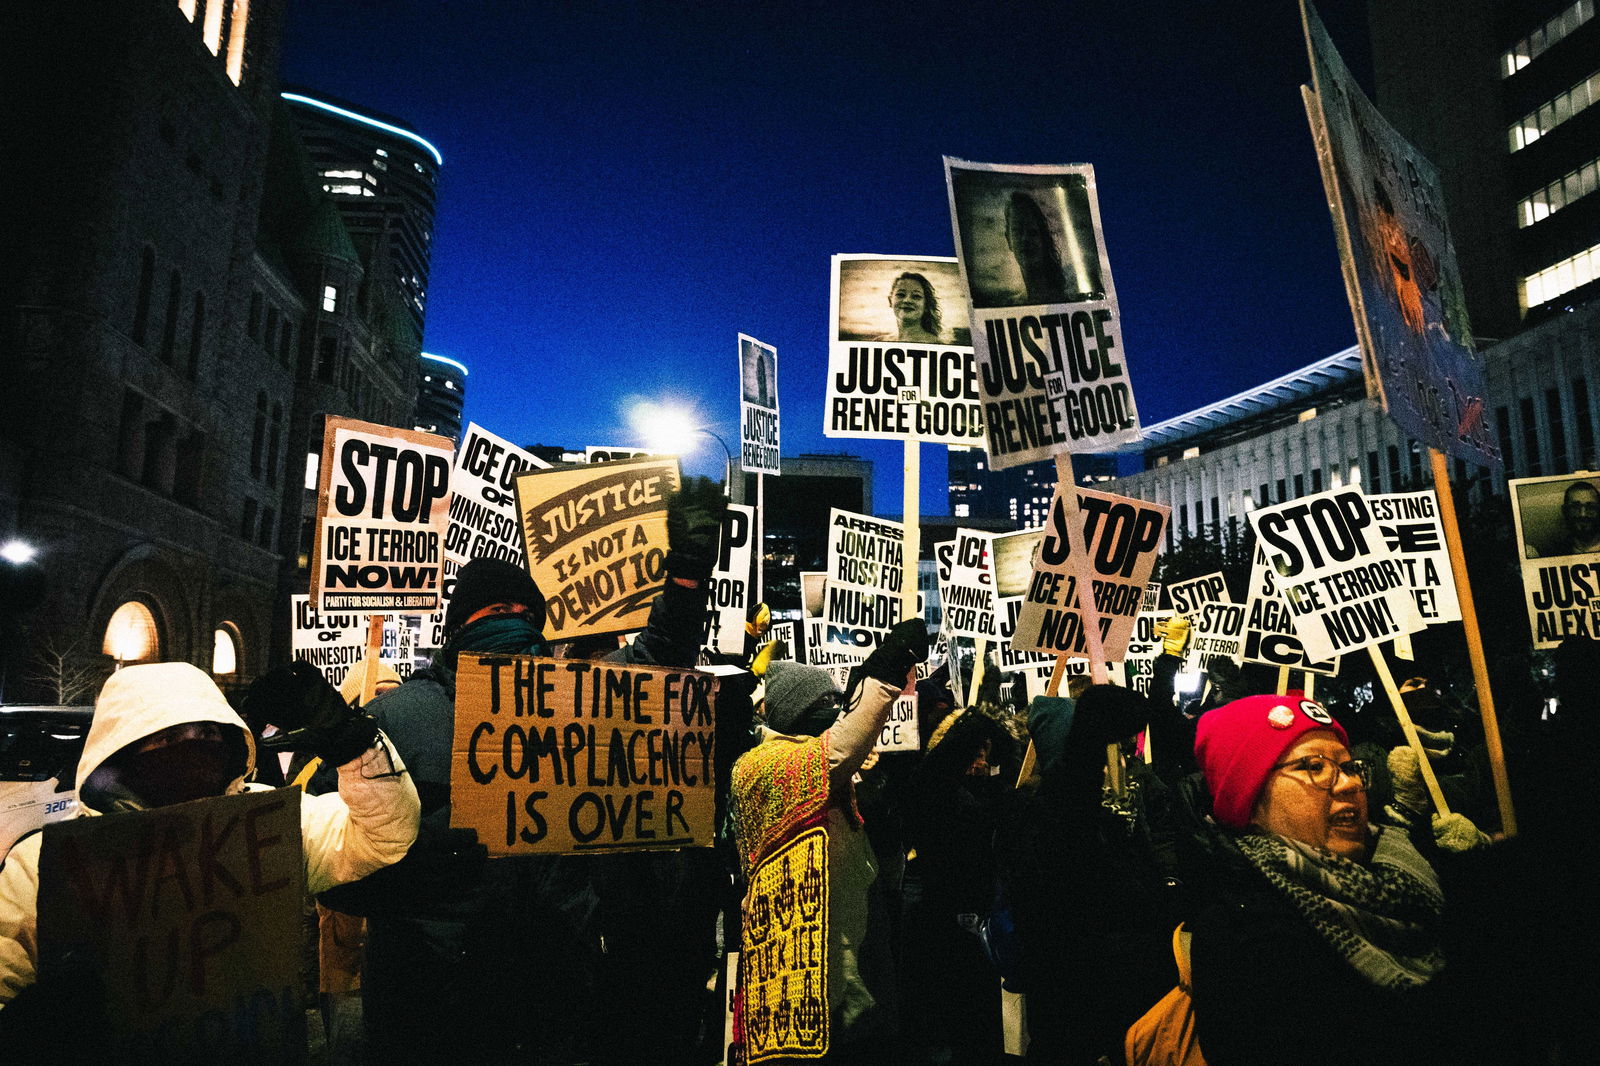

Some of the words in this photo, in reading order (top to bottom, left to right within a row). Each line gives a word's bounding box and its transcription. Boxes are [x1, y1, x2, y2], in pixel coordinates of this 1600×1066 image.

[981, 309, 1123, 397] JUSTICE
[835, 347, 979, 400] JUSTICE
[1048, 376, 1064, 395] FOR
[901, 390, 917, 401] FOR
[744, 406, 778, 446] JUSTICE
[832, 397, 910, 433] RENEE
[916, 400, 985, 438] GOOD
[985, 395, 1067, 456] RENEE
[1065, 382, 1136, 441] GOOD
[462, 433, 505, 484] ICE
[743, 442, 763, 468] RENEE
[764, 446, 779, 470] GOOD
[335, 438, 449, 524] STOP
[481, 486, 515, 508] OF
[449, 491, 522, 549] MINNESOT
[541, 475, 662, 544] JUSTICE
[834, 514, 904, 541] ARRES
[1368, 496, 1435, 521] ESTING
[326, 525, 361, 562] ICE
[366, 528, 439, 564] TERROR
[444, 522, 471, 557] OR
[835, 530, 904, 567] JONATHA
[1042, 493, 1164, 578] STOP
[1258, 491, 1371, 577] STOP
[552, 553, 581, 583] IS
[584, 527, 628, 566] NOT
[631, 524, 649, 547] A
[838, 555, 879, 588] ROSS
[1424, 557, 1441, 586] A
[325, 564, 438, 589] NOW!
[545, 547, 668, 632] DEMOTIO
[706, 577, 744, 609] ROR
[1027, 570, 1065, 605] ICE
[1171, 576, 1225, 614] STOP
[1284, 580, 1327, 617] ICE
[1319, 559, 1402, 605] TERROR
[1532, 563, 1600, 610] JUST
[325, 596, 348, 608] PARTY
[349, 596, 361, 607] FOR
[362, 596, 395, 607] SOCIALISM
[395, 596, 403, 607] &
[404, 596, 436, 607] LIBERATION
[828, 586, 904, 631] MURDE
[949, 584, 994, 611] MINNE
[318, 631, 342, 642] OF
[773, 626, 792, 640] THE
[1320, 596, 1400, 650] NOW!
[1537, 608, 1594, 643] ALEX
[295, 645, 363, 666] MINNESOTA
[1128, 644, 1153, 653] OF
[1193, 637, 1208, 651] ICE
[1209, 639, 1240, 655] TERRO
[478, 657, 556, 718] THE
[565, 663, 653, 724] TIME
[663, 673, 712, 727] FOR
[887, 701, 913, 722] LISH
[467, 721, 715, 787] COMPLACENCY
[880, 725, 903, 747] CE
[506, 790, 548, 847] IS
[568, 789, 690, 843] OVER
[61, 800, 291, 928] WAKE
[134, 910, 242, 1012] UP
